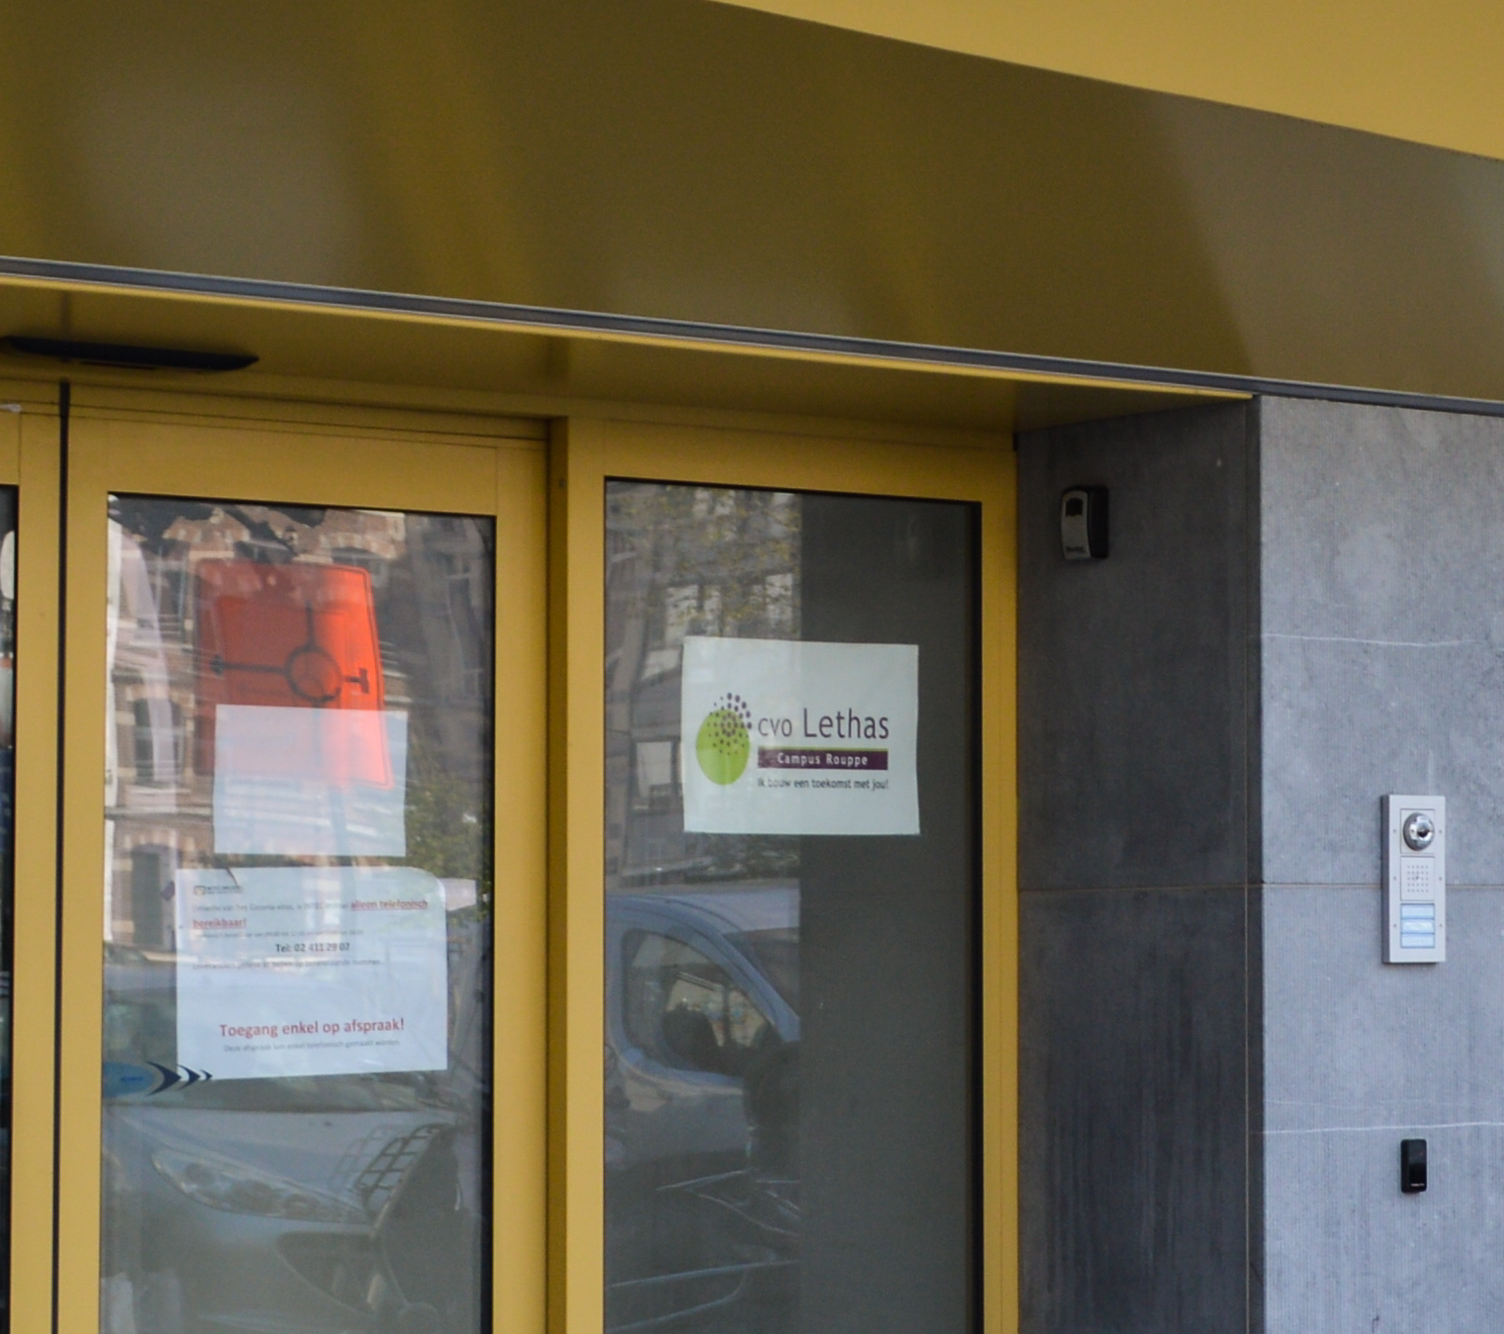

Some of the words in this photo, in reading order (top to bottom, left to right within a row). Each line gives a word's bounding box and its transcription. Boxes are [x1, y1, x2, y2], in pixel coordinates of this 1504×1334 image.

[758, 718, 793, 737] cvo
[803, 708, 889, 739] Lethas
[777, 752, 821, 766] Campus
[826, 753, 868, 767] Rouppe
[793, 779, 809, 788] een
[812, 778, 851, 789] toekomst
[853, 779, 870, 789] met
[274, 943, 291, 953] Tel:
[294, 943, 306, 952] 02
[219, 1023, 278, 1039] Toegang
[282, 1021, 318, 1034] enkel
[322, 1022, 340, 1034] op
[344, 1017, 404, 1034] afspraak!
